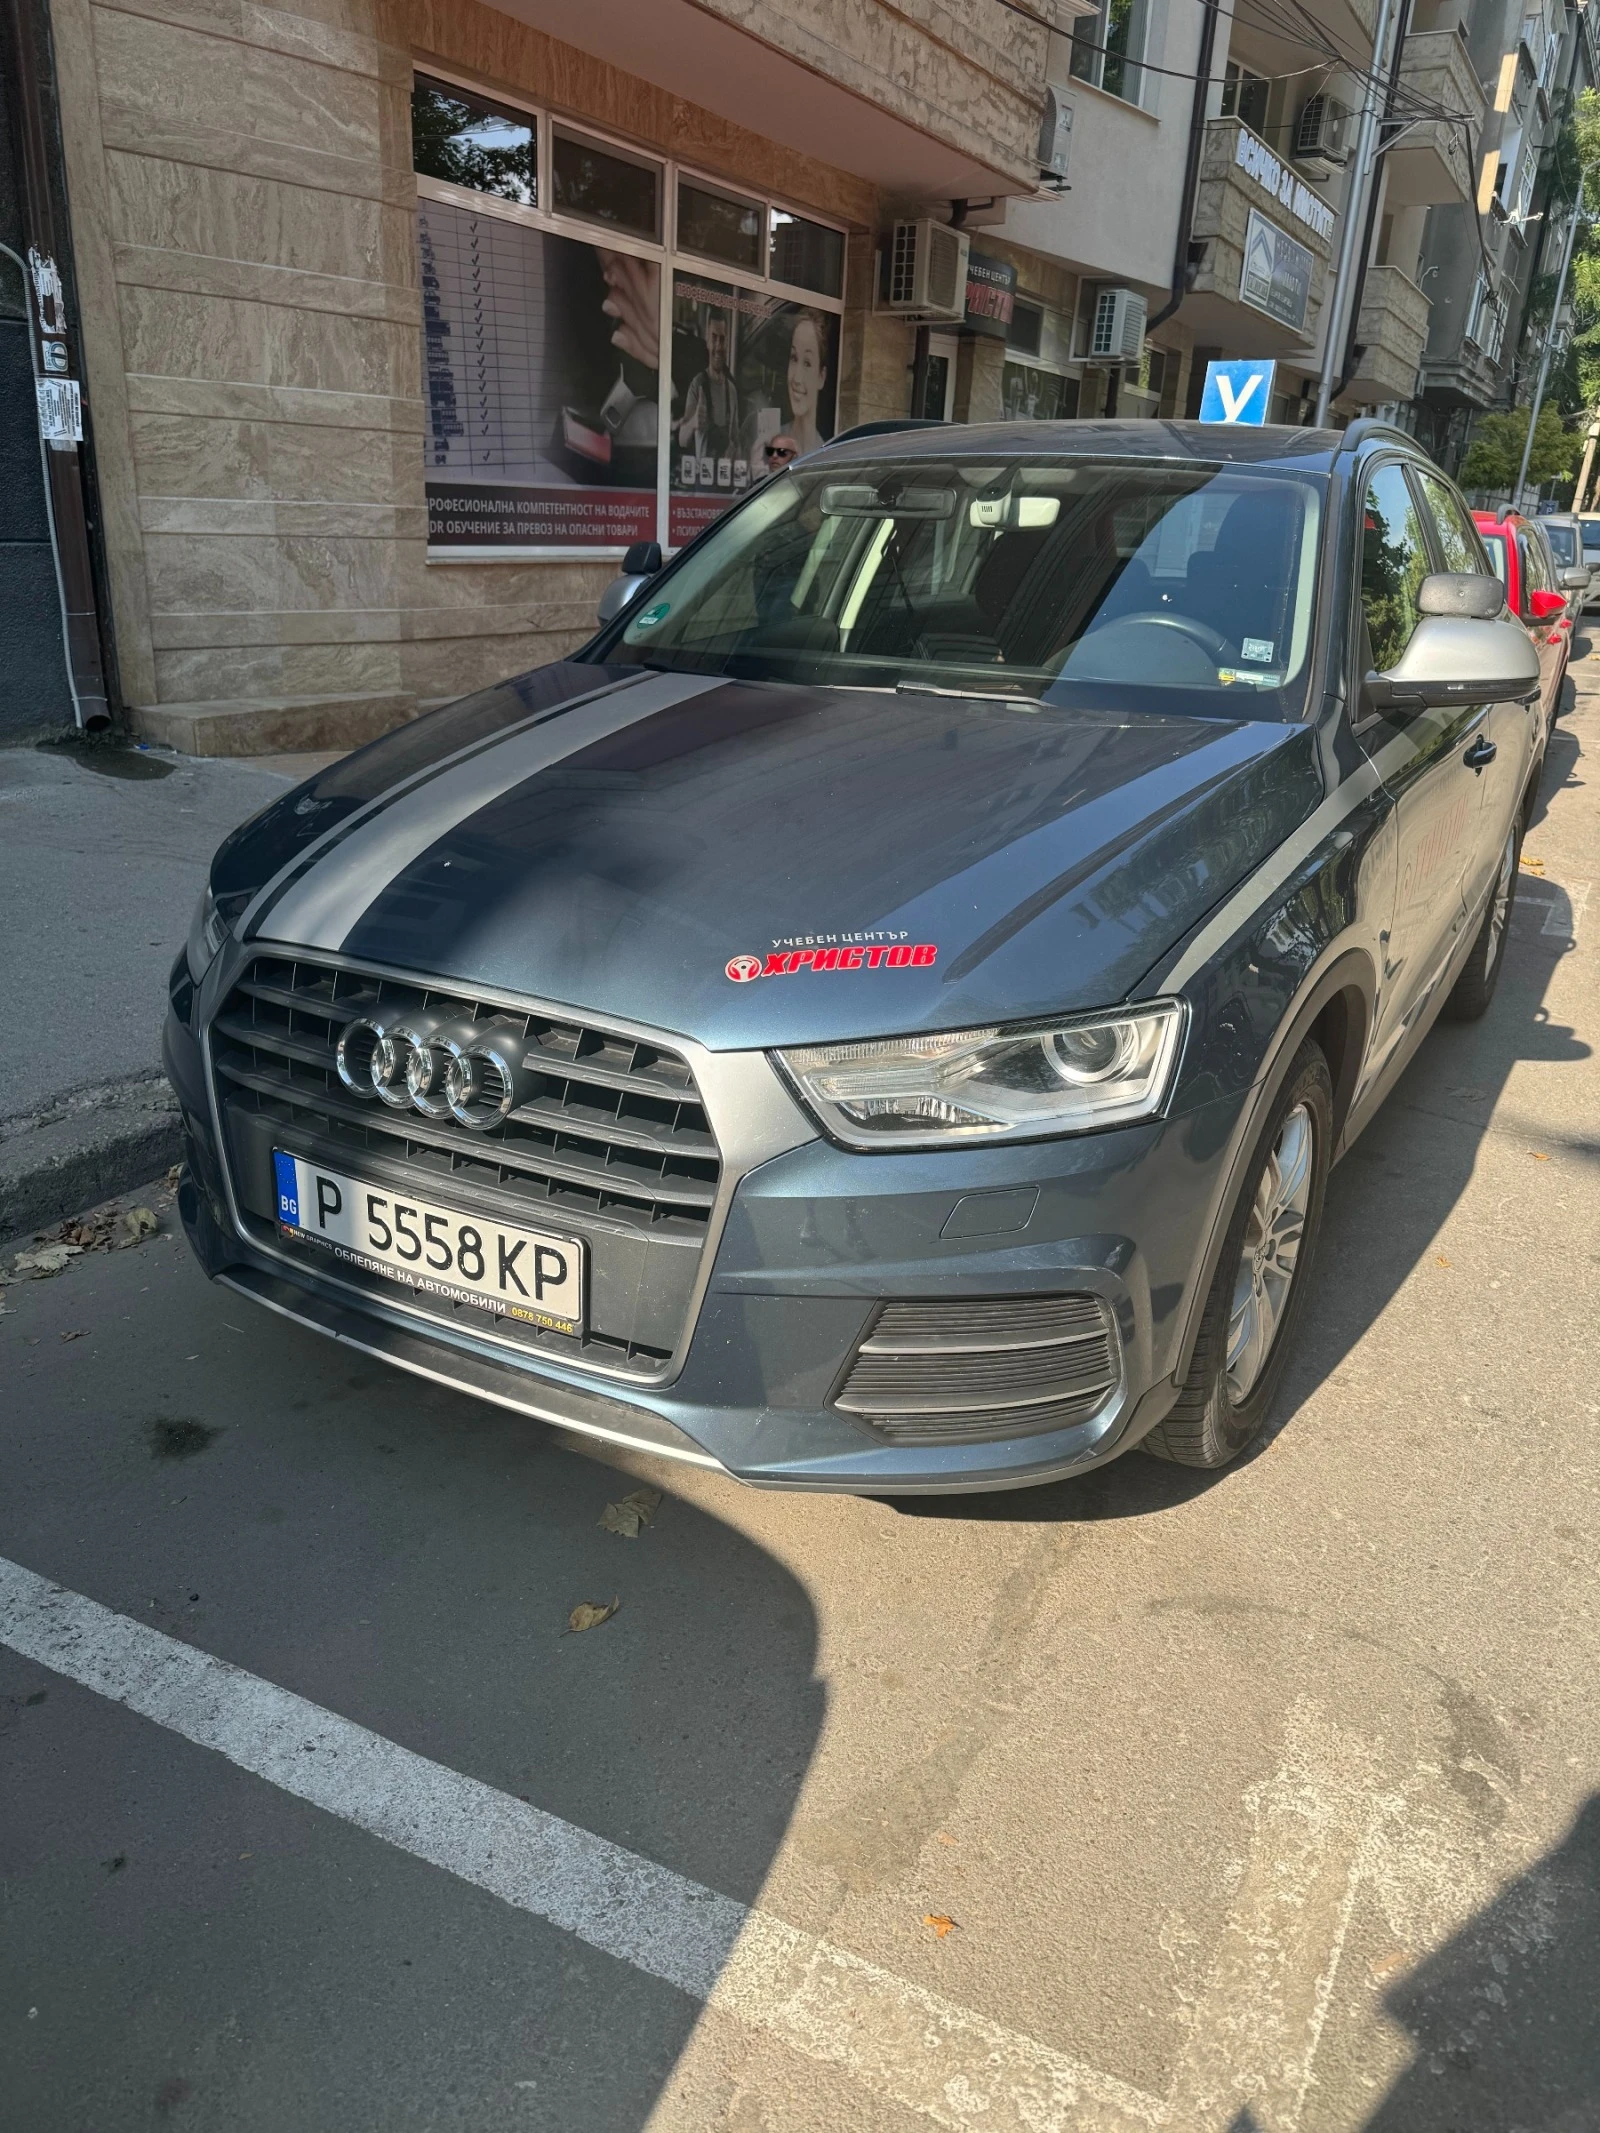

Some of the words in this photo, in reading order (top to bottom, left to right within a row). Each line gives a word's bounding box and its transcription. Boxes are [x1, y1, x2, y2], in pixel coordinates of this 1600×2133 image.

[1235, 128, 1281, 196] ВСИЧКО
[1279, 170, 1294, 210] ЗА
[968, 264, 991, 279] ЧЕБЕН
[428, 497, 515, 514] РОФЕСИОНАЛНА
[517, 501, 593, 517] КОМПЕТЕНТНОСТ
[594, 505, 607, 517] НА
[608, 505, 651, 519] ВОДАЧИТЕ
[429, 520, 445, 534] DR
[446, 520, 501, 535] ОБУЧЕНИЕ
[503, 521, 516, 535] ЗА
[517, 522, 553, 536] ПРЕВОЗ
[555, 523, 568, 536] НА
[568, 524, 605, 537] ОПАСНИ
[606, 525, 639, 537] ТОВАРИ
[772, 933, 837, 949] УЧЕБЕН
[842, 930, 909, 944] ЦЕНТЪР
[760, 944, 938, 978] ХРИСТОВ
[281, 1194, 297, 1216] BG
[366, 1193, 485, 1282] 5558
[334, 1246, 395, 1280] ОБЛЕПЯНЕ
[397, 1269, 415, 1287] НА
[417, 1277, 506, 1315] АВТОМОБИЛИ
[511, 1306, 534, 1323] 0878
[536, 1313, 553, 1328] 750
[555, 1319, 573, 1334] 446
